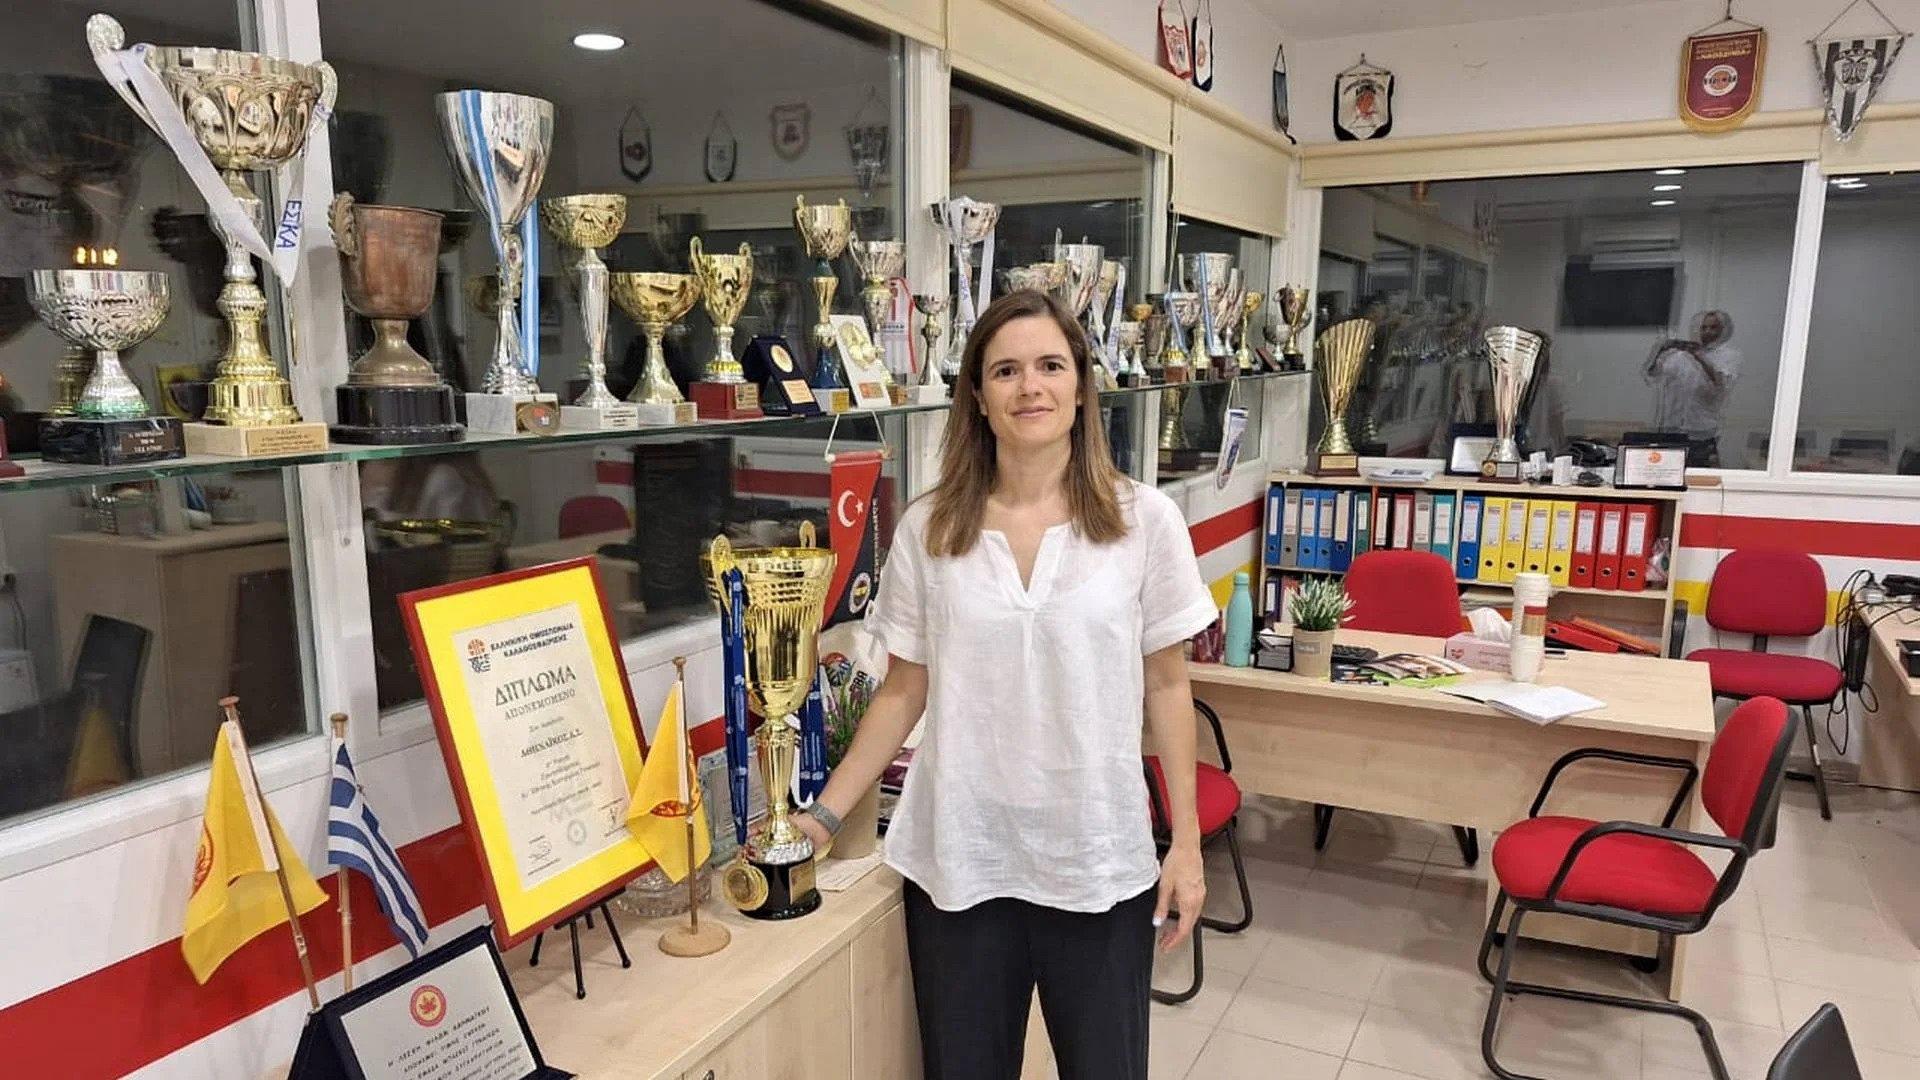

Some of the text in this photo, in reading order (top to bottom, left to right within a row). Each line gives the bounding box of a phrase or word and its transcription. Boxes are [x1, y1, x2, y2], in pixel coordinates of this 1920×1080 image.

[276, 200, 302, 248] ΕΣΚΑ
[495, 665, 576, 706] ΔΙΠΛΩΜΑ
[505, 688, 575, 720] ΑΠΟΝΕΜΟΜΕΝΟ
